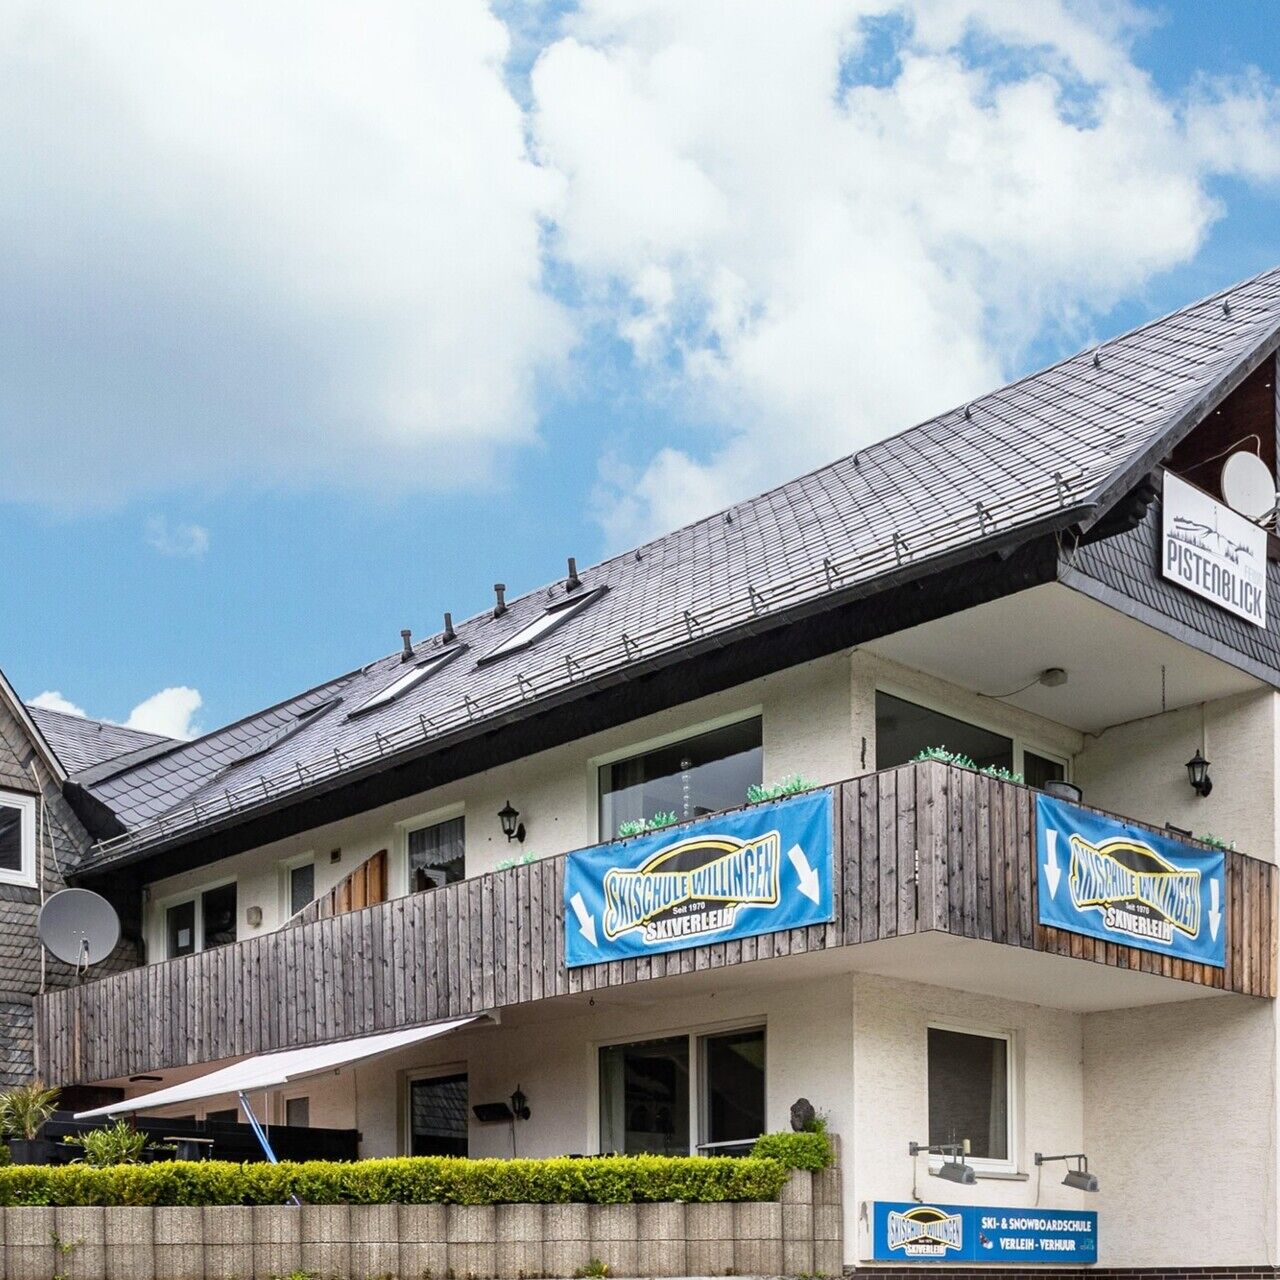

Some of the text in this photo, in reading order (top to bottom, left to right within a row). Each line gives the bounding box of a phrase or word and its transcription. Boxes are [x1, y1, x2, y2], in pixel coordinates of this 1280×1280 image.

[1167, 539, 1262, 619] PISTENBLICK
[607, 842, 774, 930] SKISCHULE WILLINGEN
[672, 901, 706, 915] Seit 1970
[646, 907, 736, 941] SKIVERLEIH
[981, 1216, 1092, 1232] SKI- & SNOWBOARDSCHULE
[999, 1237, 1034, 1250] VERLEIH
[1039, 1238, 1076, 1251] VERHUUR
